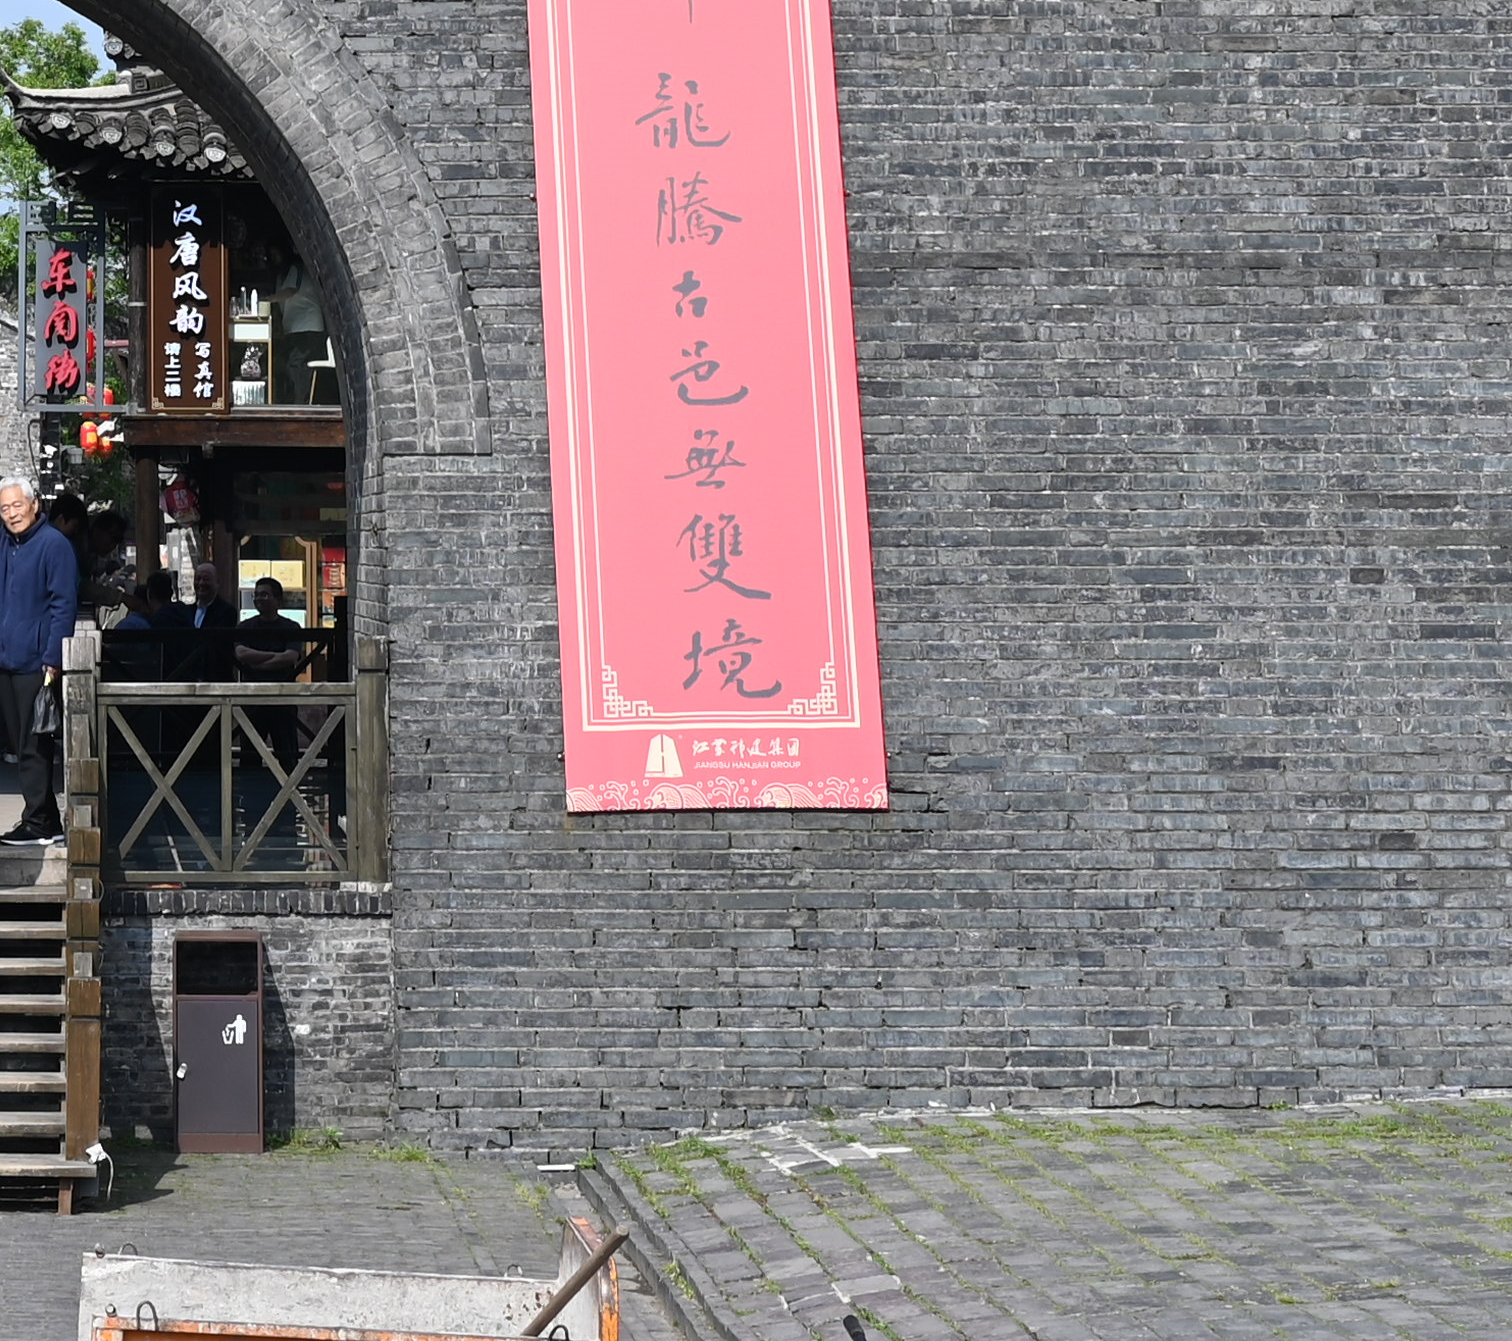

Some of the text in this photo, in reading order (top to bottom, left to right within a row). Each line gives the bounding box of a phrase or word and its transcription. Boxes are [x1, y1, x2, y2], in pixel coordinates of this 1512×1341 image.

[169, 200, 208, 334] 汉唐风韵
[163, 341, 182, 398] 请上二楼
[193, 341, 215, 399] 写真馆
[770, 760, 801, 769] GROUP
